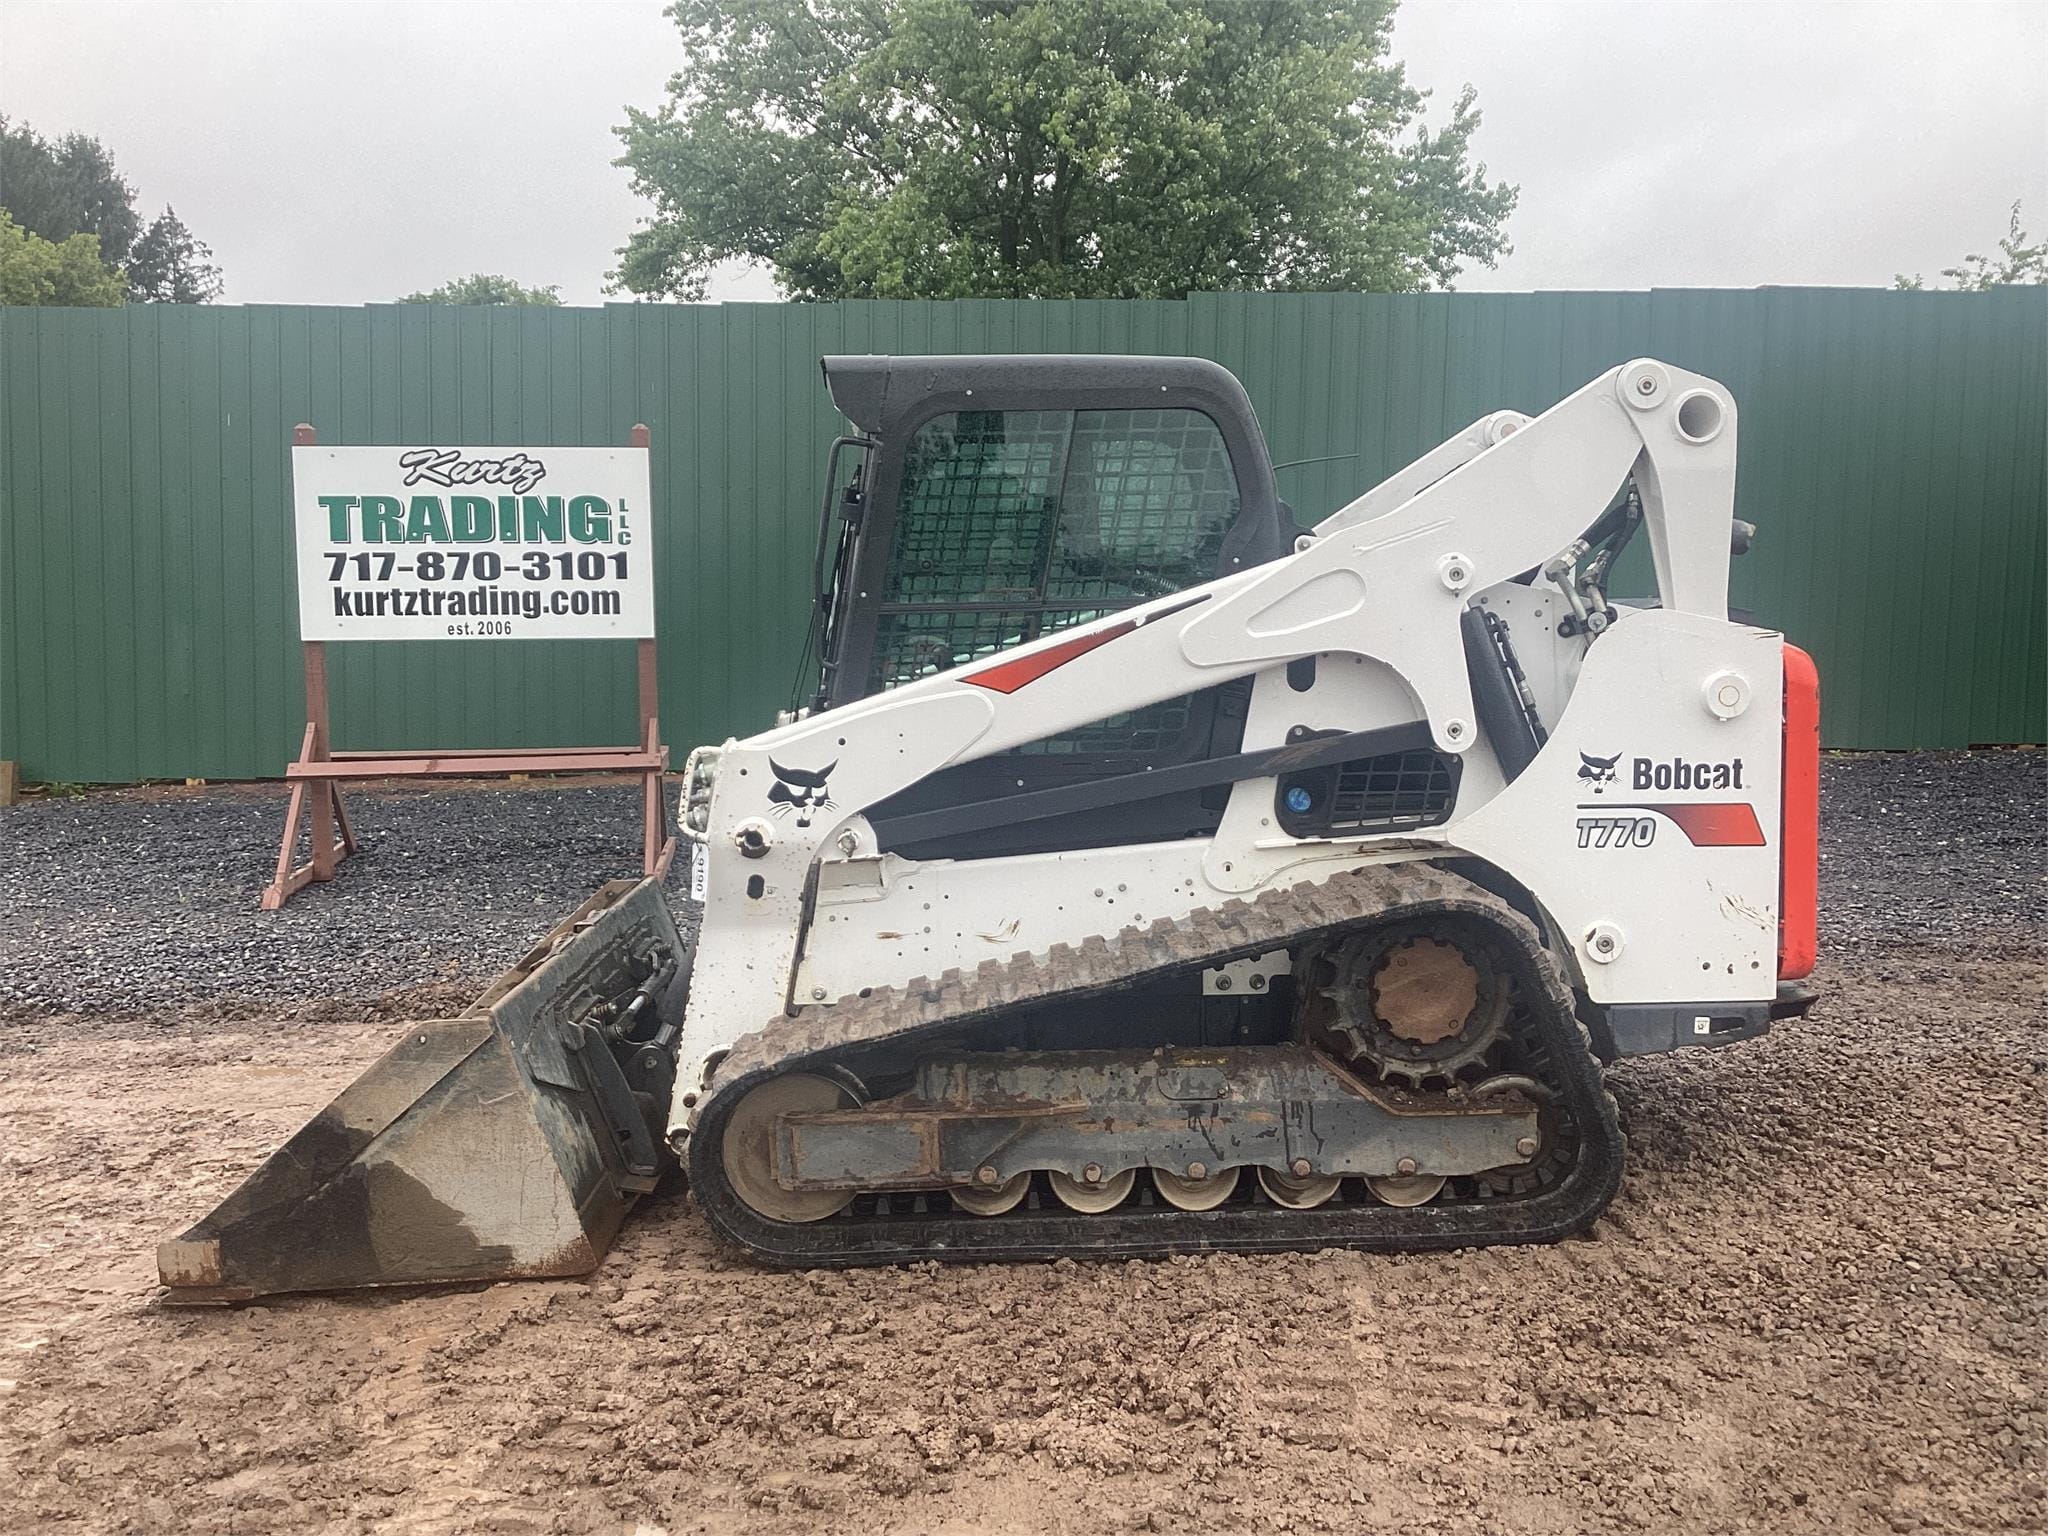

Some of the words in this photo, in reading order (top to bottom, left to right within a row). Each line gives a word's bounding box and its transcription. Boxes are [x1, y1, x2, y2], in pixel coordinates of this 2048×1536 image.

[400, 449, 547, 495] Kurtz
[317, 495, 613, 545] TRADING
[618, 498, 632, 546] LLC
[323, 551, 628, 582] 717-870-3101
[333, 585, 621, 619] kurtztrading.com
[447, 622, 474, 636] est.
[477, 621, 512, 636] 2006
[1633, 757, 1743, 790] Bobcat
[1576, 817, 1657, 848] T770
